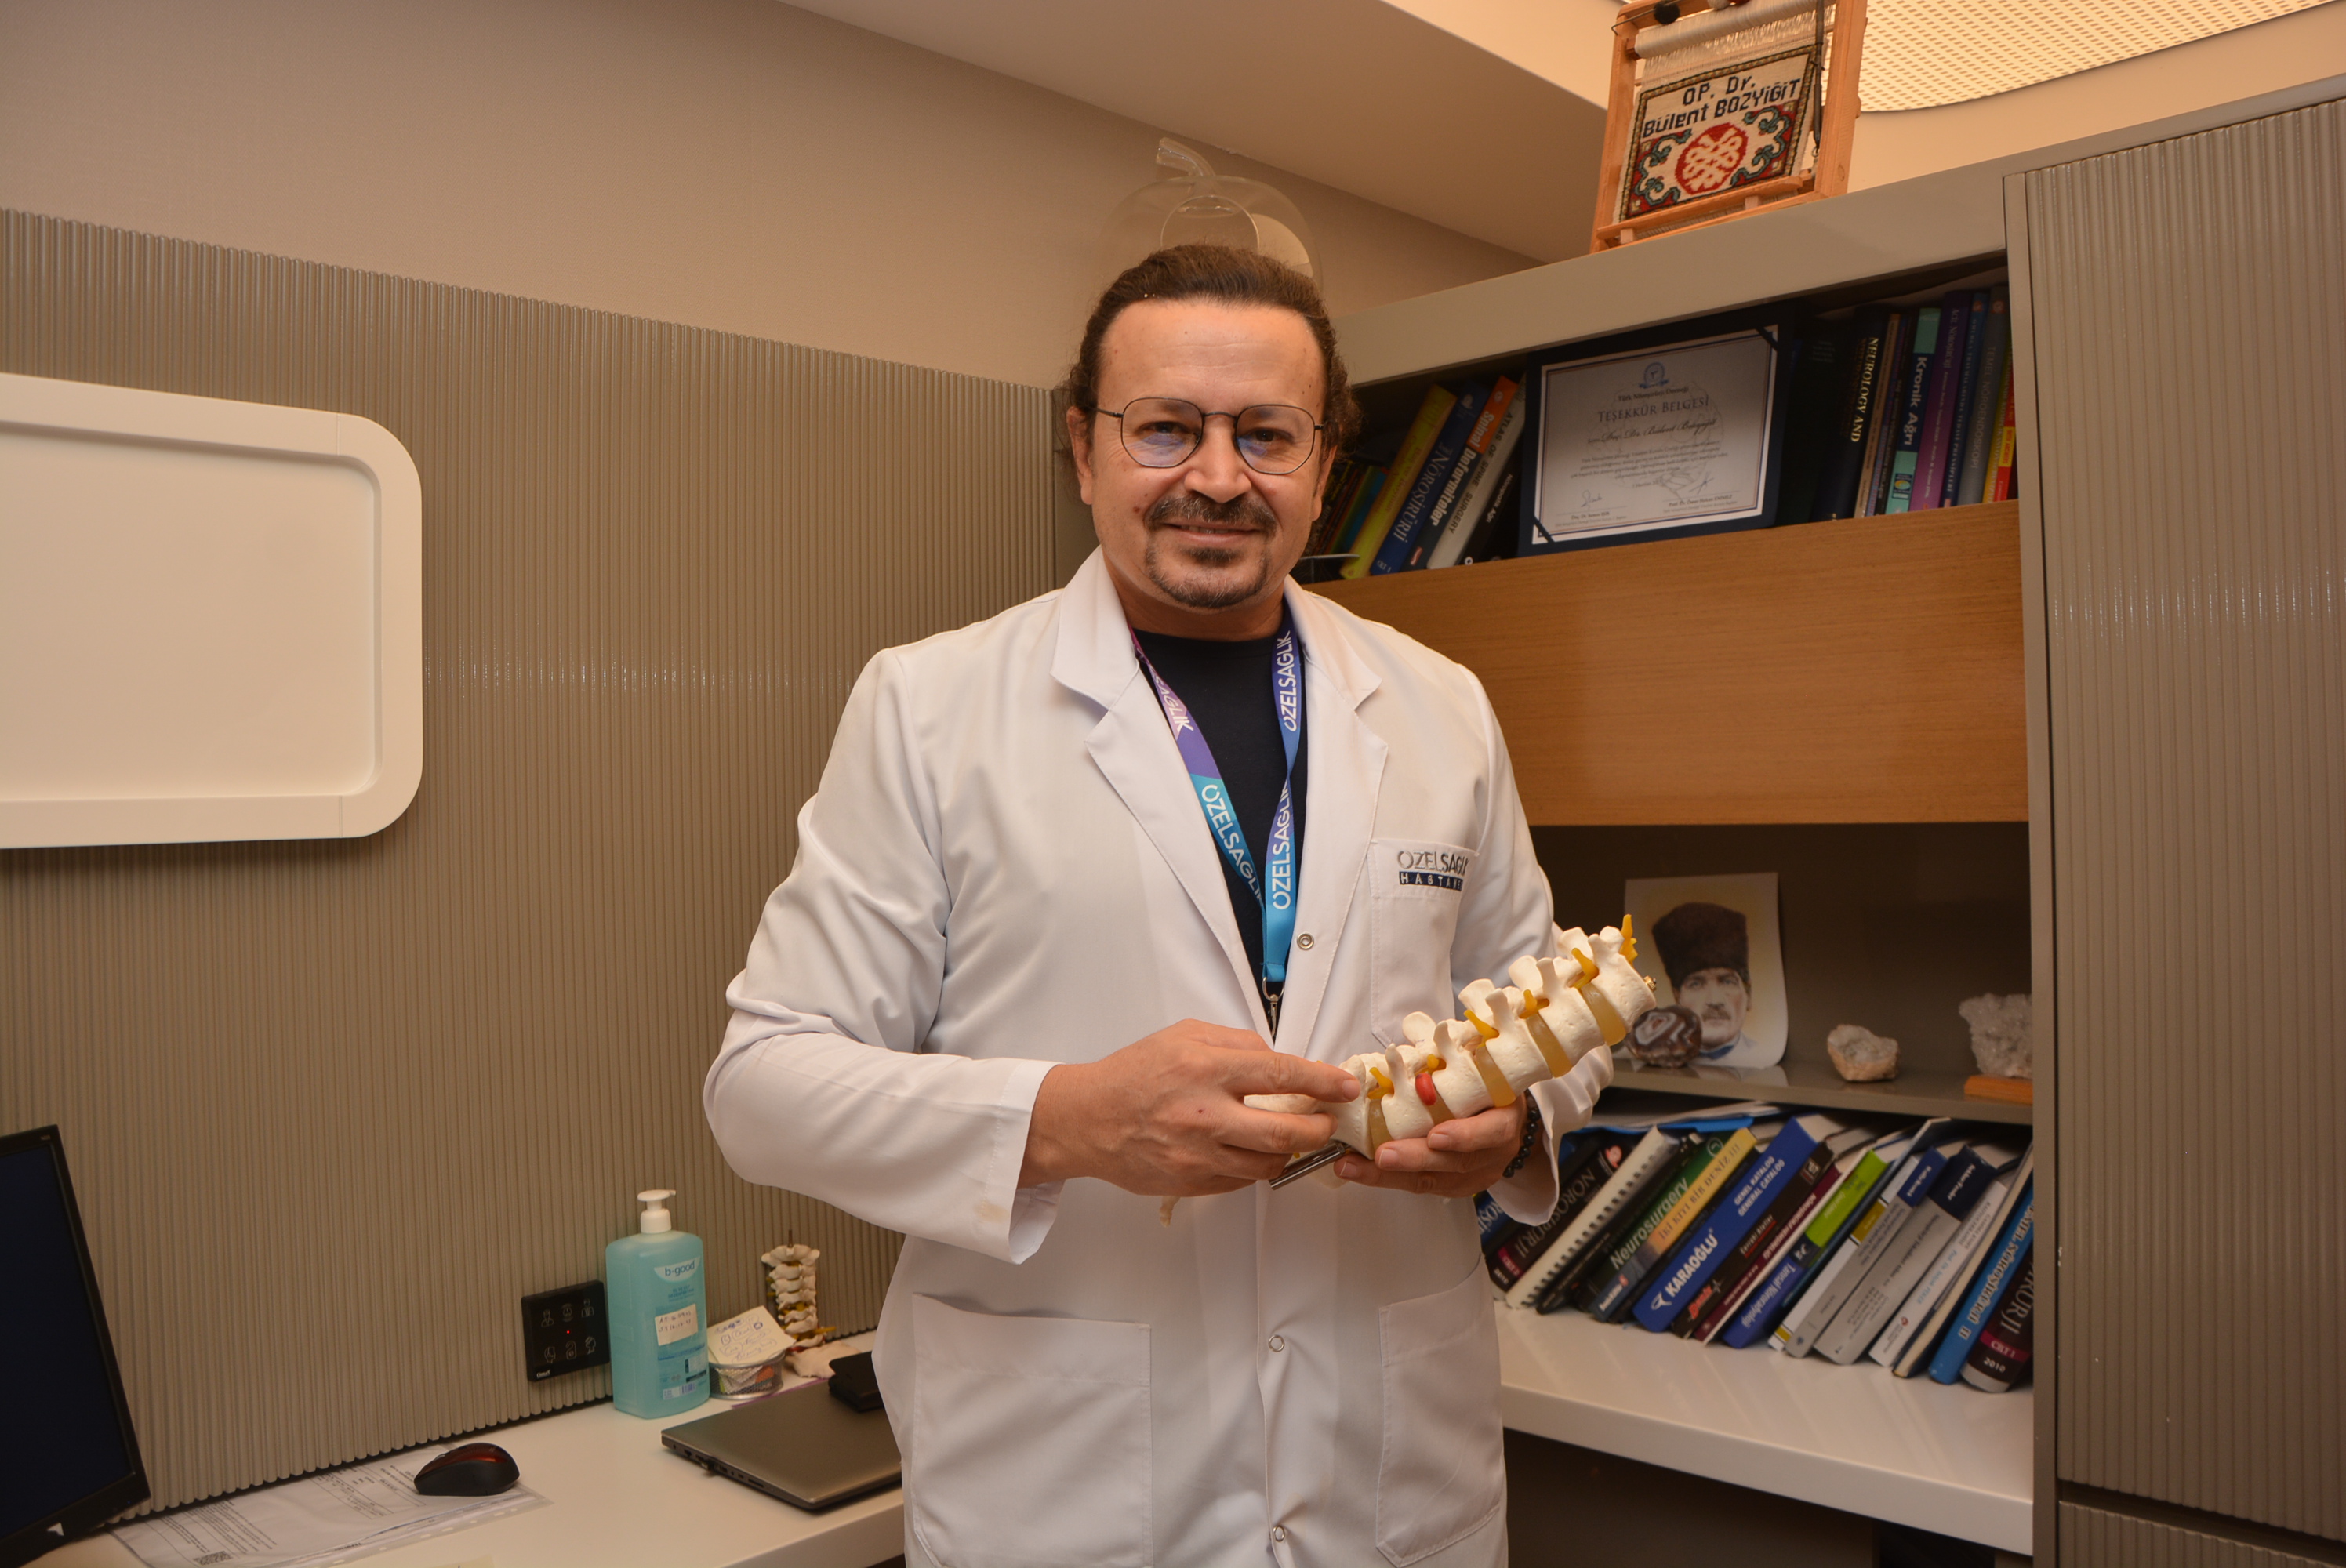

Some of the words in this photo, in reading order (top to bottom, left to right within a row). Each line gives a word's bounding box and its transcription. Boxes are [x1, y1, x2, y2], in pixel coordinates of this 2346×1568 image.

[1857, 336, 1879, 413] NEUROLOGY
[1910, 356, 1928, 408] Kronik
[1496, 412, 1513, 441] ATLAS
[1598, 404, 1658, 423] TEŞEKKÜR
[1662, 394, 1709, 412] BELGESİ
[1469, 411, 1495, 448] Spinal
[1850, 415, 1865, 443] AND
[1902, 412, 1919, 446] Ağrı
[1487, 445, 1497, 458] OF
[1429, 448, 1477, 526] Deformiteler
[1472, 460, 1489, 486] SPINE
[1450, 492, 1473, 534] SURGERY
[1734, 1181, 1755, 1206] GENEL
[1750, 1156, 1774, 1187] KATALOG
[1738, 1186, 1763, 1216] GENERAL
[1761, 1160, 1785, 1192] CATALOG
[1665, 1233, 1720, 1298] KARAOĞLU
[1983, 1356, 2006, 1373] 2010
